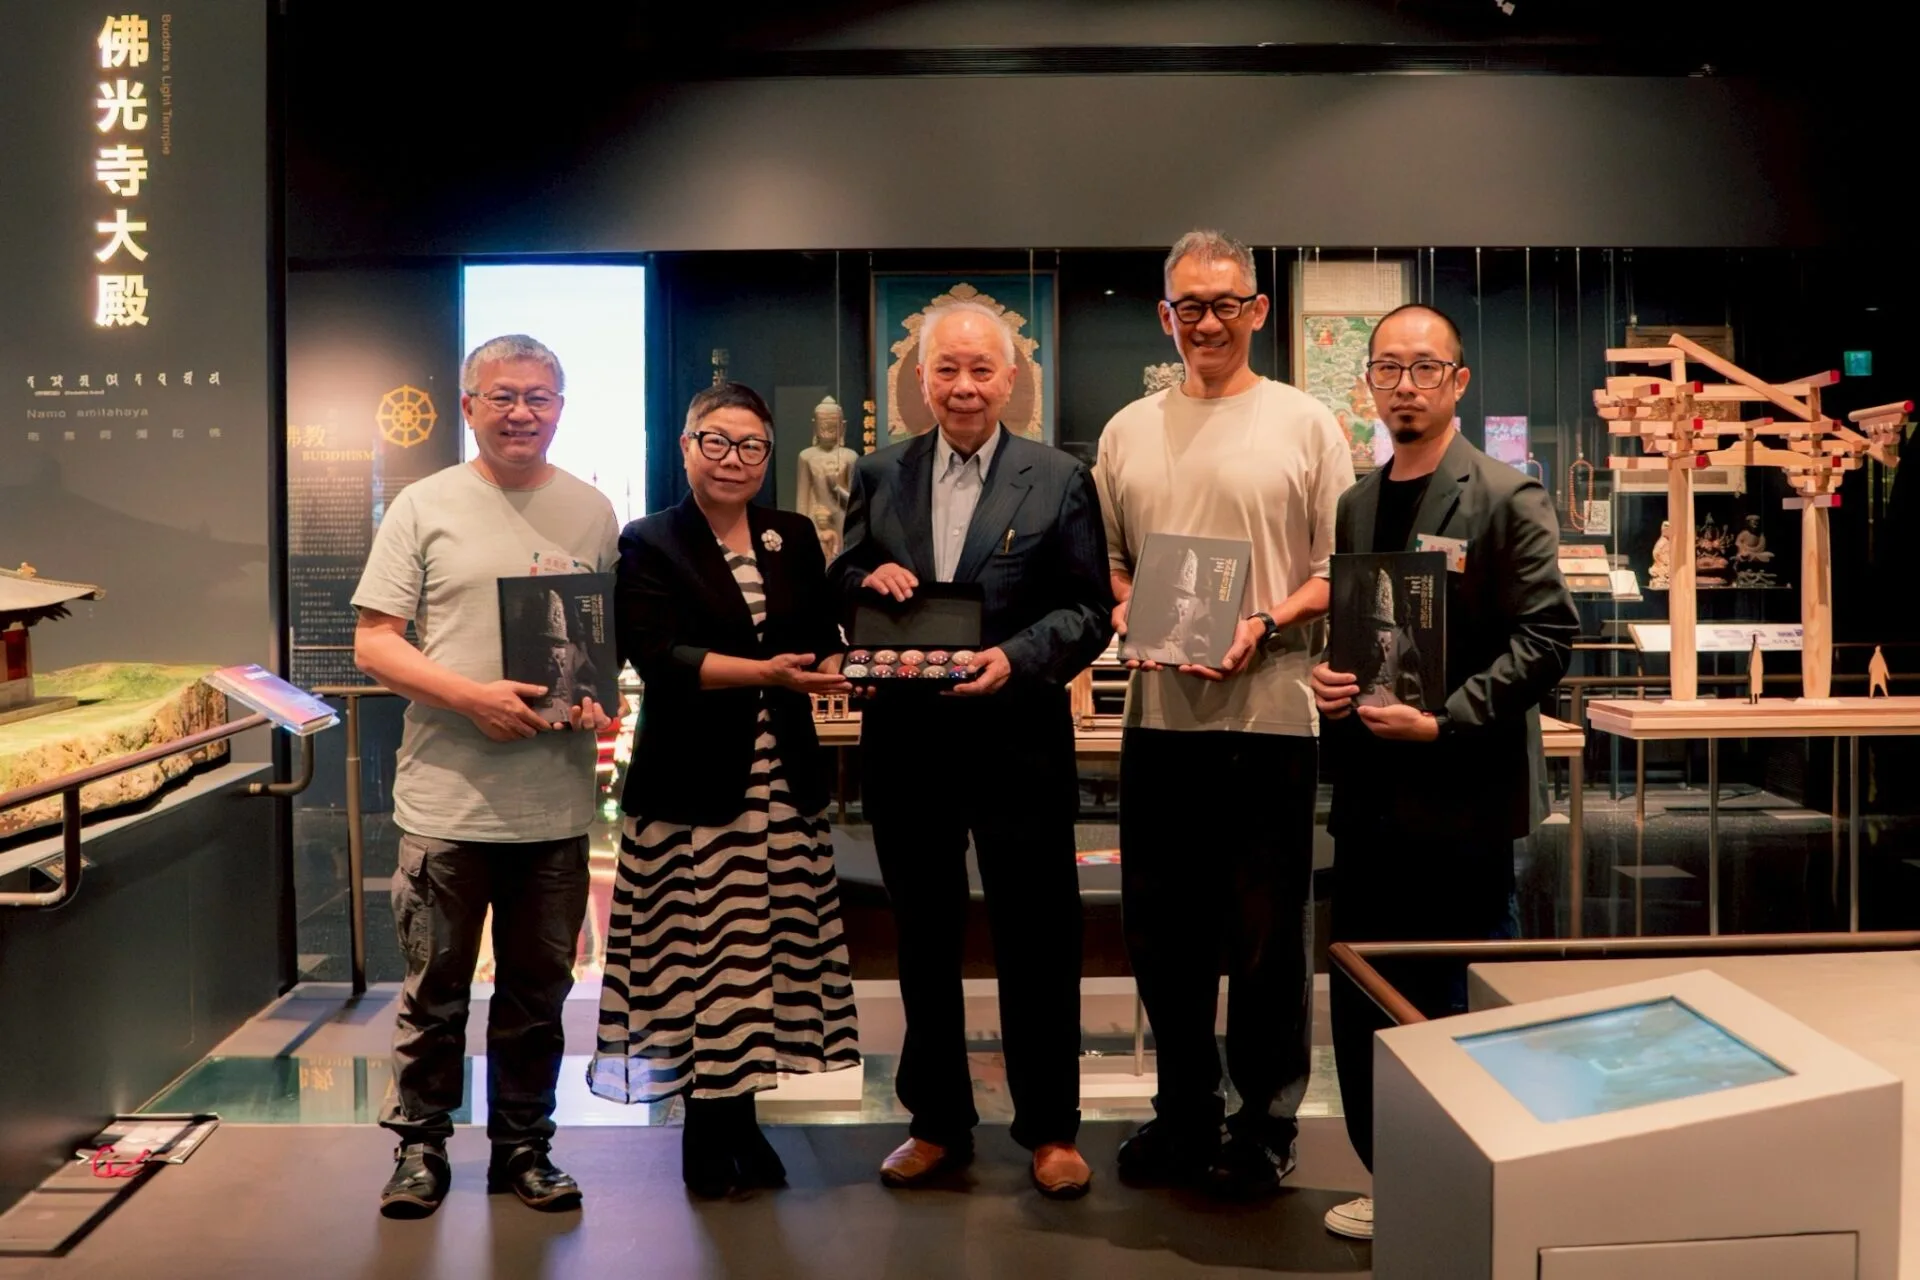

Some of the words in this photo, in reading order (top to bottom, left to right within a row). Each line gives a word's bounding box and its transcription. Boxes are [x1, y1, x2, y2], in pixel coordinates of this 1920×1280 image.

[161, 14, 172, 71] Buddha's
[160, 75, 172, 106] Light
[161, 109, 173, 155] Temple
[96, 14, 149, 328] 佛光寺大殿
[27, 409, 67, 419] Namo
[302, 450, 376, 461] BUDDHISM
